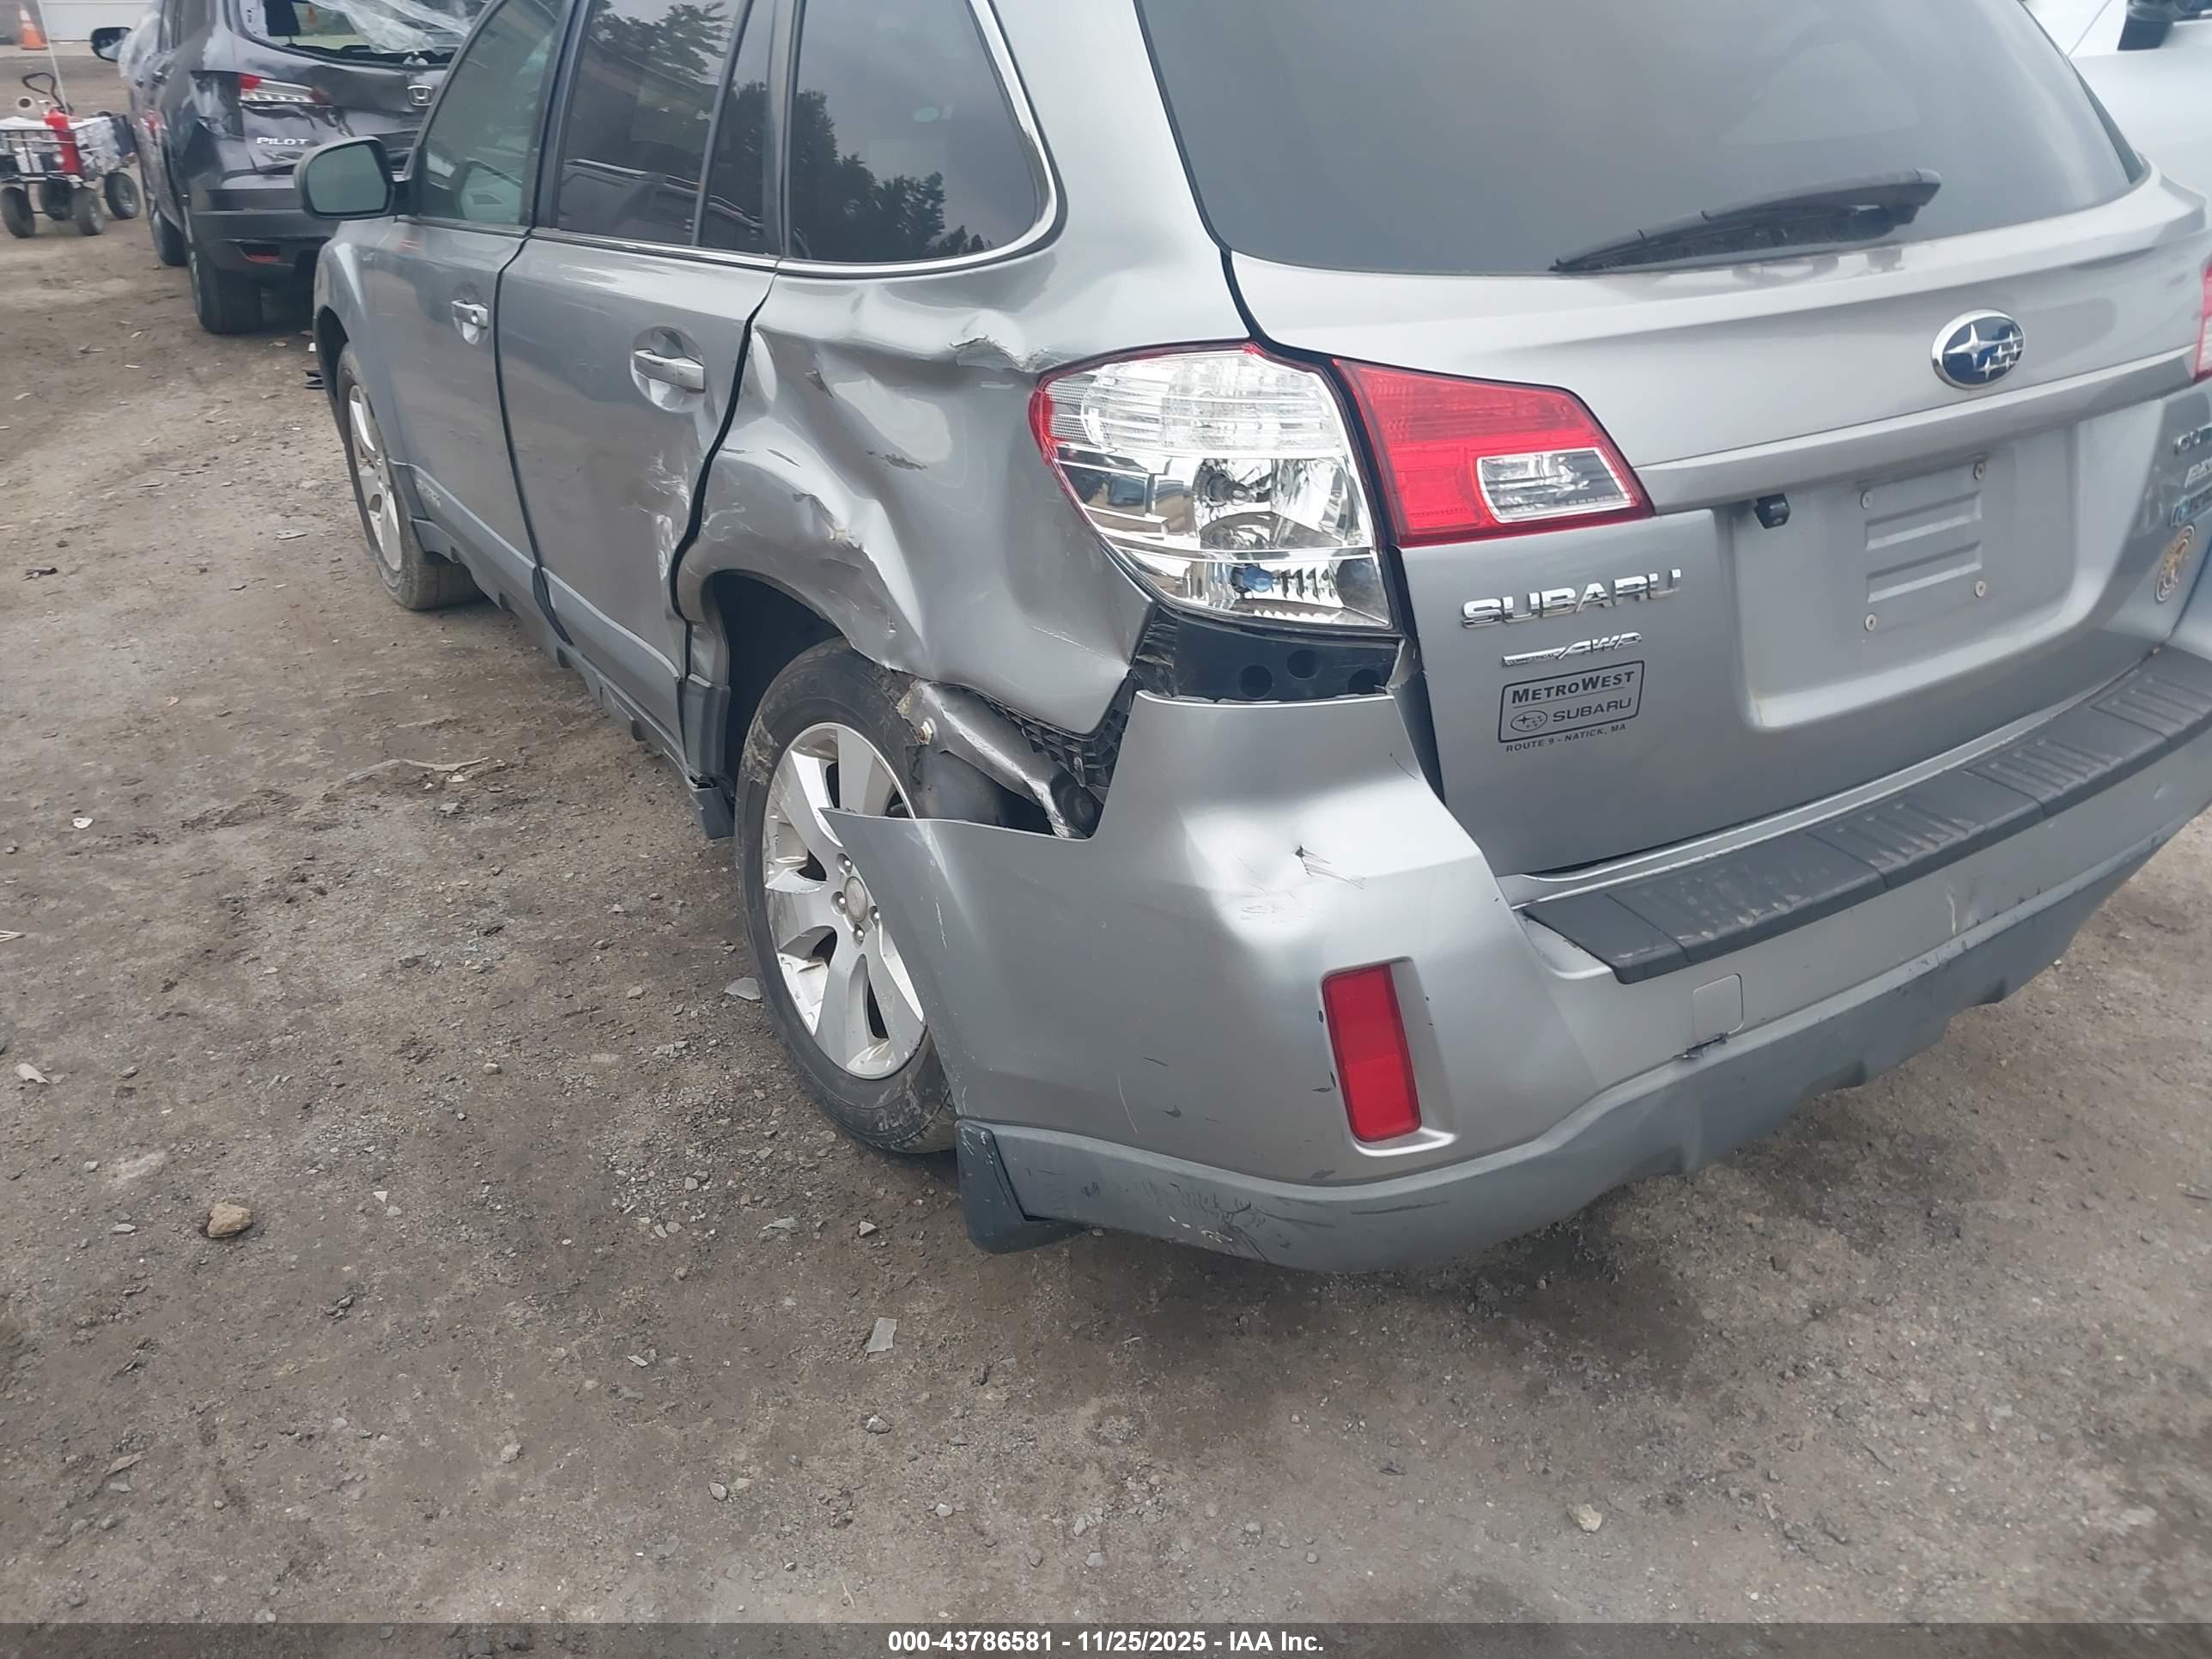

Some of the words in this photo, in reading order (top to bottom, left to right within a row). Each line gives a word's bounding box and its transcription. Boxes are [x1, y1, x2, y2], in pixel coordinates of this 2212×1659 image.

[256, 137, 310, 146] PILOT
[1461, 568, 1682, 628] SUBARU
[1558, 632, 1642, 659] AWD
[1553, 697, 1632, 722] SUBARU
[1506, 739, 1546, 752] ROUTE
[1565, 728, 1607, 742] NATICK,
[1611, 723, 1626, 732] MA
